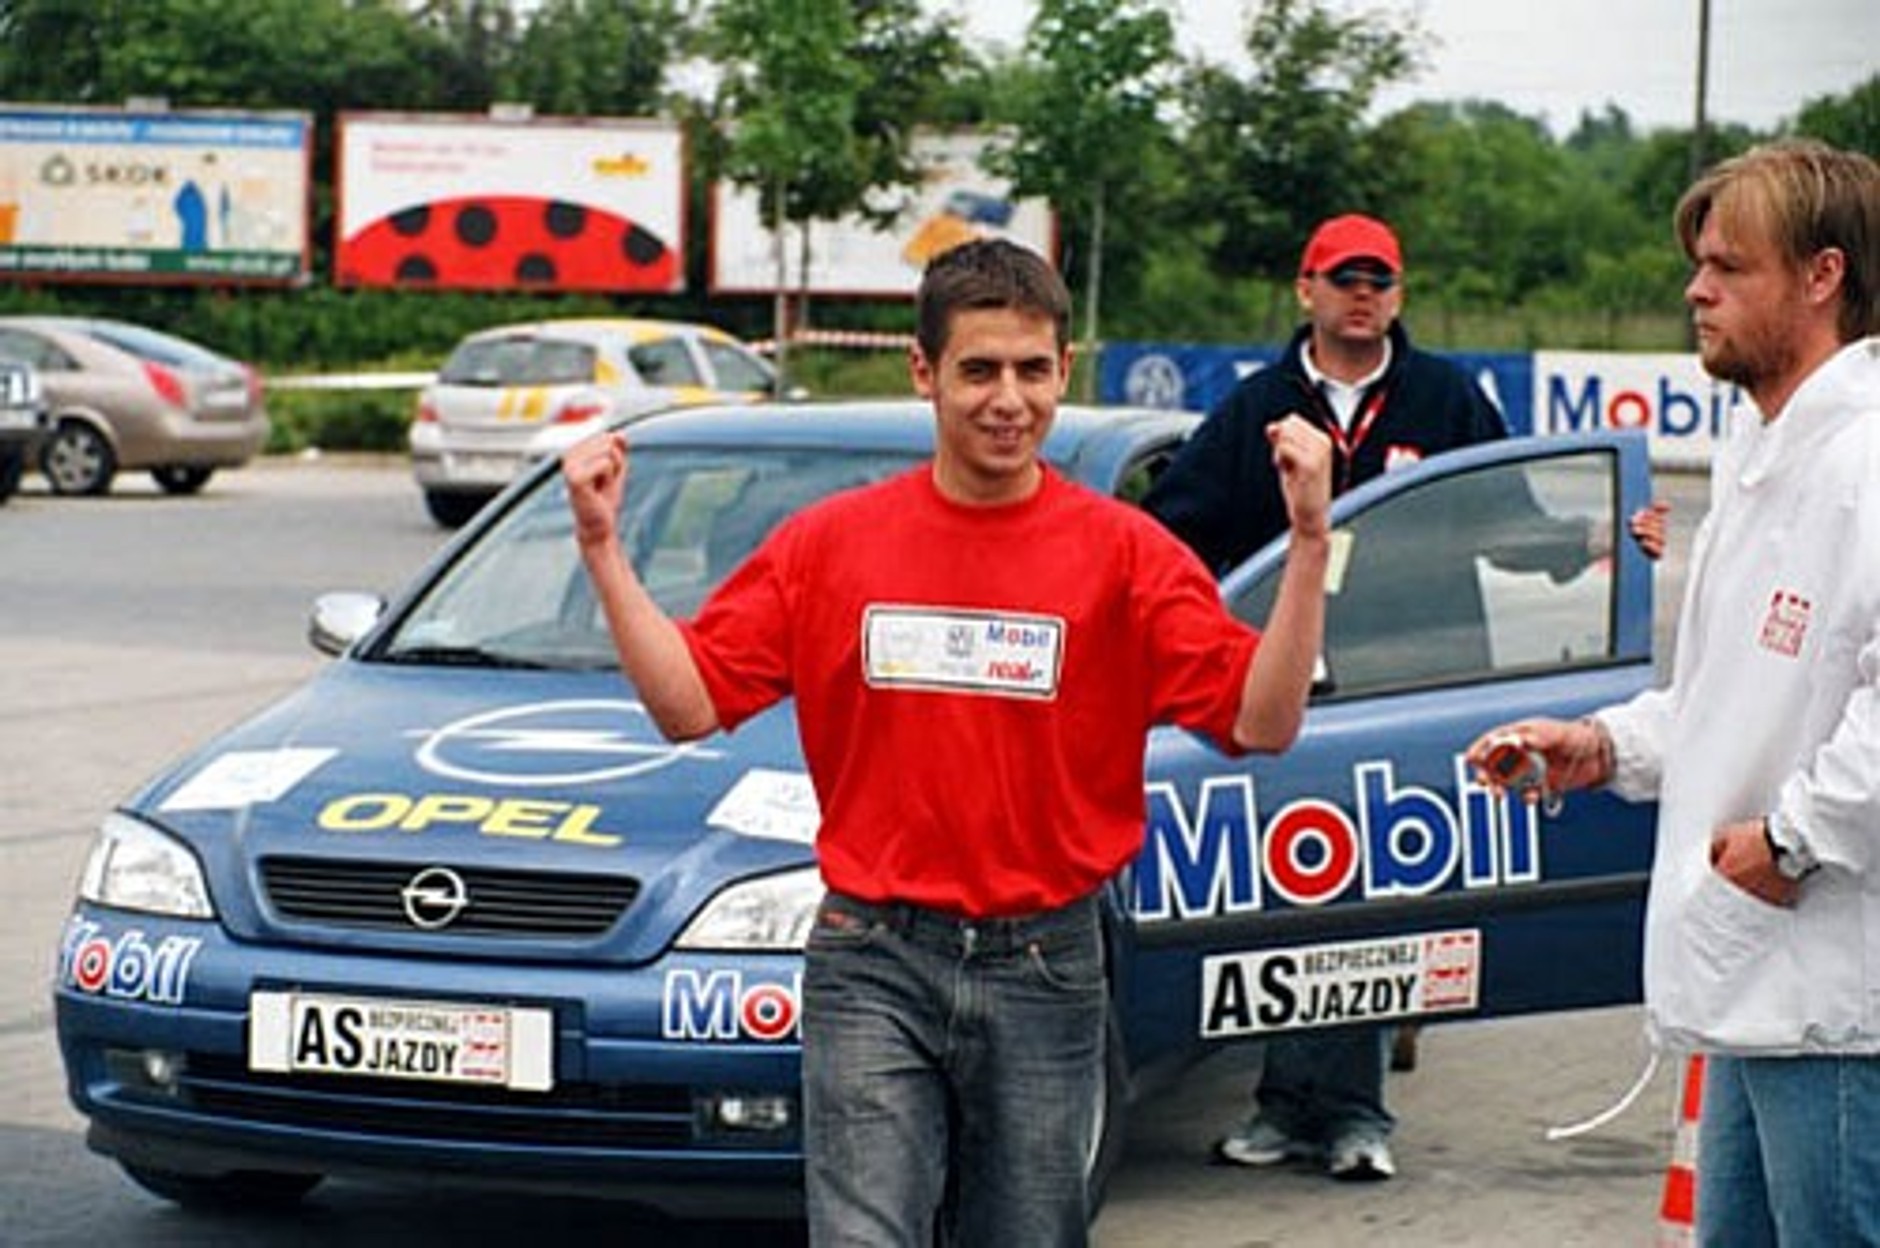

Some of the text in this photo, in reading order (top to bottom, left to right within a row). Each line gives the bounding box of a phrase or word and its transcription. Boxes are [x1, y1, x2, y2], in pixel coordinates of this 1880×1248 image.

[1549, 375, 1740, 437] Mobi
[986, 621, 1051, 648] Mobil
[317, 793, 624, 846] OPEL
[1136, 753, 1540, 922] Mobil
[1303, 939, 1419, 976] BEZPIECZNEJ
[662, 968, 804, 1041] Mo
[1206, 954, 1298, 1032] AS
[1299, 972, 1418, 1023] JAZDY
[296, 1006, 364, 1069] AS
[365, 1037, 459, 1076] JAZDY
